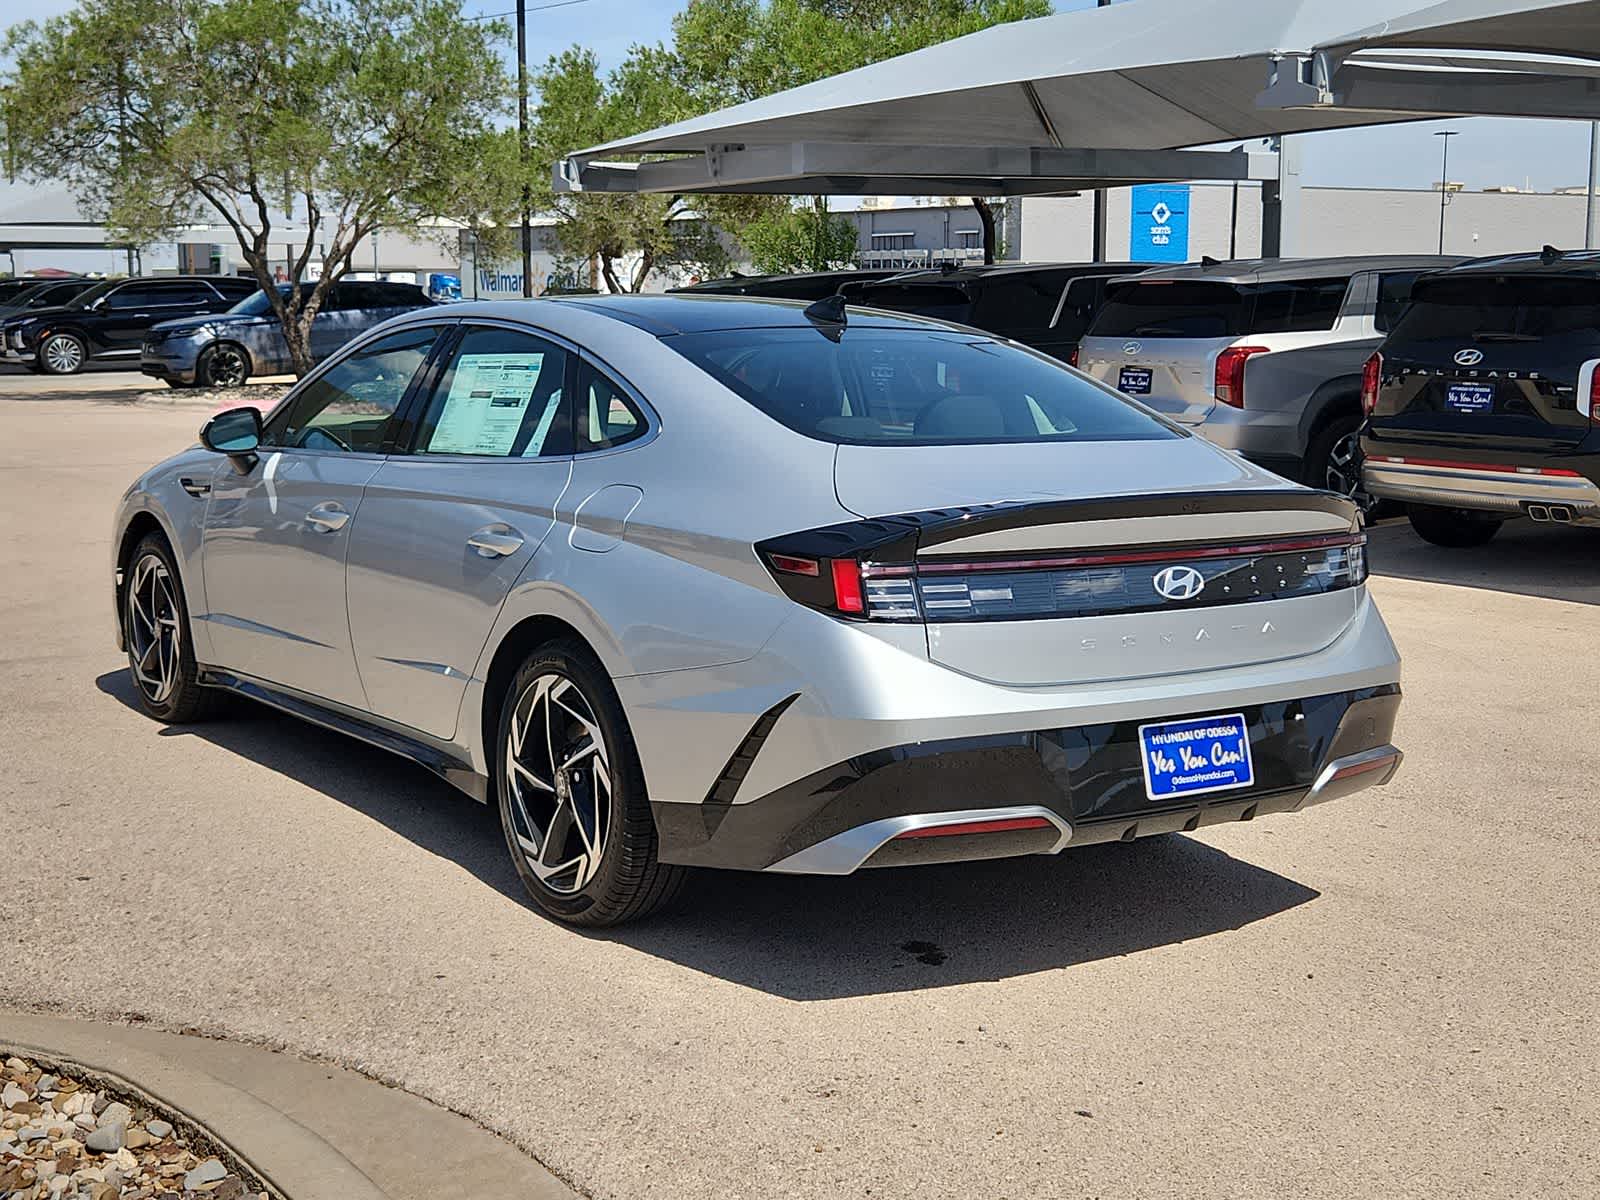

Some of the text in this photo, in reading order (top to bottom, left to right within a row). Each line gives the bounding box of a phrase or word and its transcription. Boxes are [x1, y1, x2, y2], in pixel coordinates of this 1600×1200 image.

[1152, 235, 1169, 245] club
[480, 267, 524, 292] Walmar
[1402, 368, 1540, 380] PALISADE
[1460, 392, 1471, 402] You
[1151, 725, 1239, 745] HYUNDAI OF ODESSA
[1150, 738, 1245, 775] Yes You Can!
